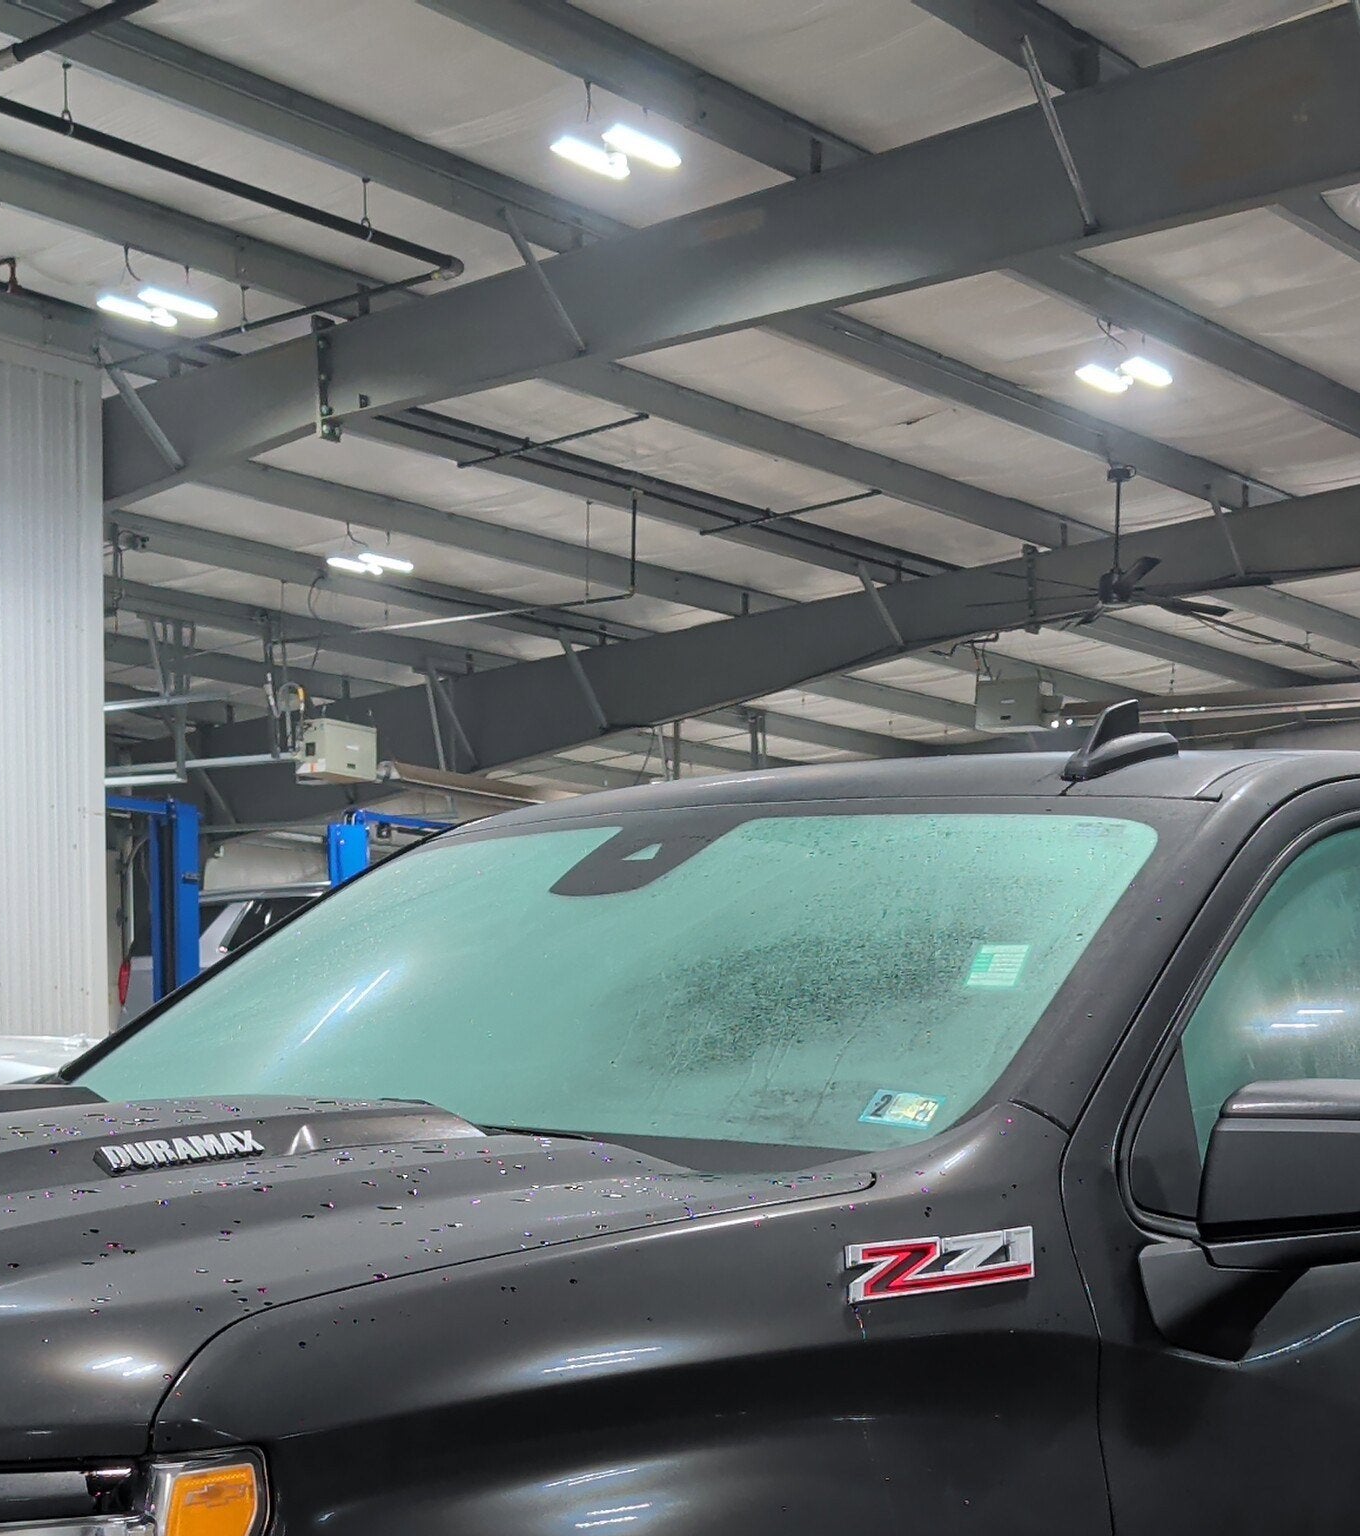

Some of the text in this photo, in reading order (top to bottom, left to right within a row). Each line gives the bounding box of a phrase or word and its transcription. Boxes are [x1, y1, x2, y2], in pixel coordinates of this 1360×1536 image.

[870, 1094, 893, 1118] 2
[100, 1130, 265, 1172] DURAMAX
[844, 1226, 1035, 1304] Z71
